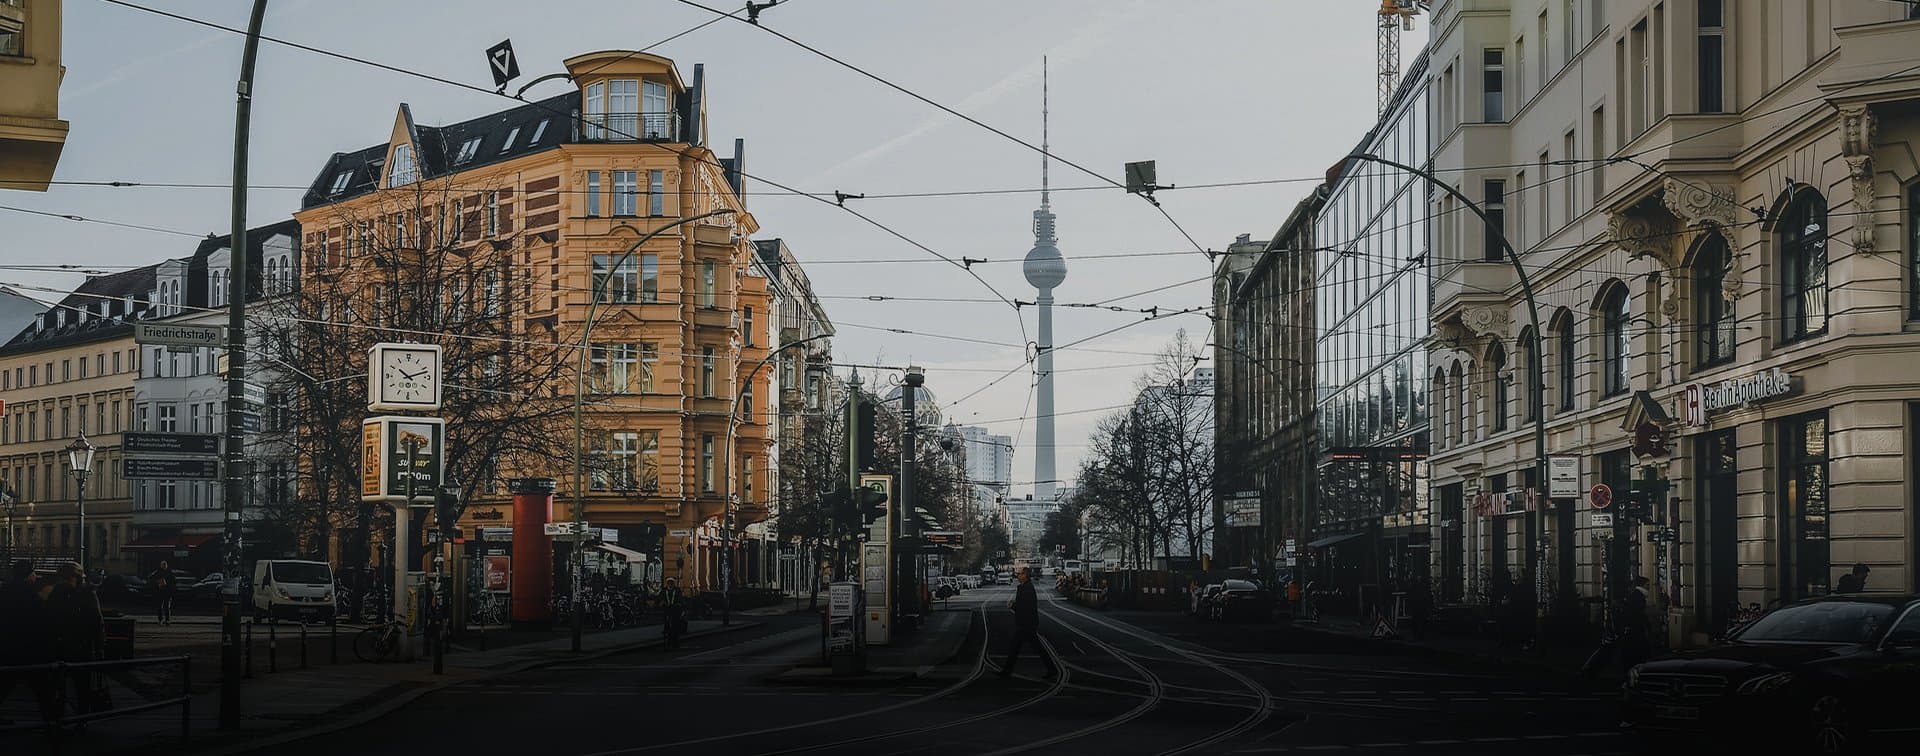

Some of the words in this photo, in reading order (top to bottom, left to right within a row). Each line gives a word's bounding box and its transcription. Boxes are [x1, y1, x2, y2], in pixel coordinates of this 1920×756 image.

[143, 326, 216, 342] Friedrichstraße
[1703, 368, 1787, 411] BerlinApotheke
[398, 459, 430, 467] SUWAY
